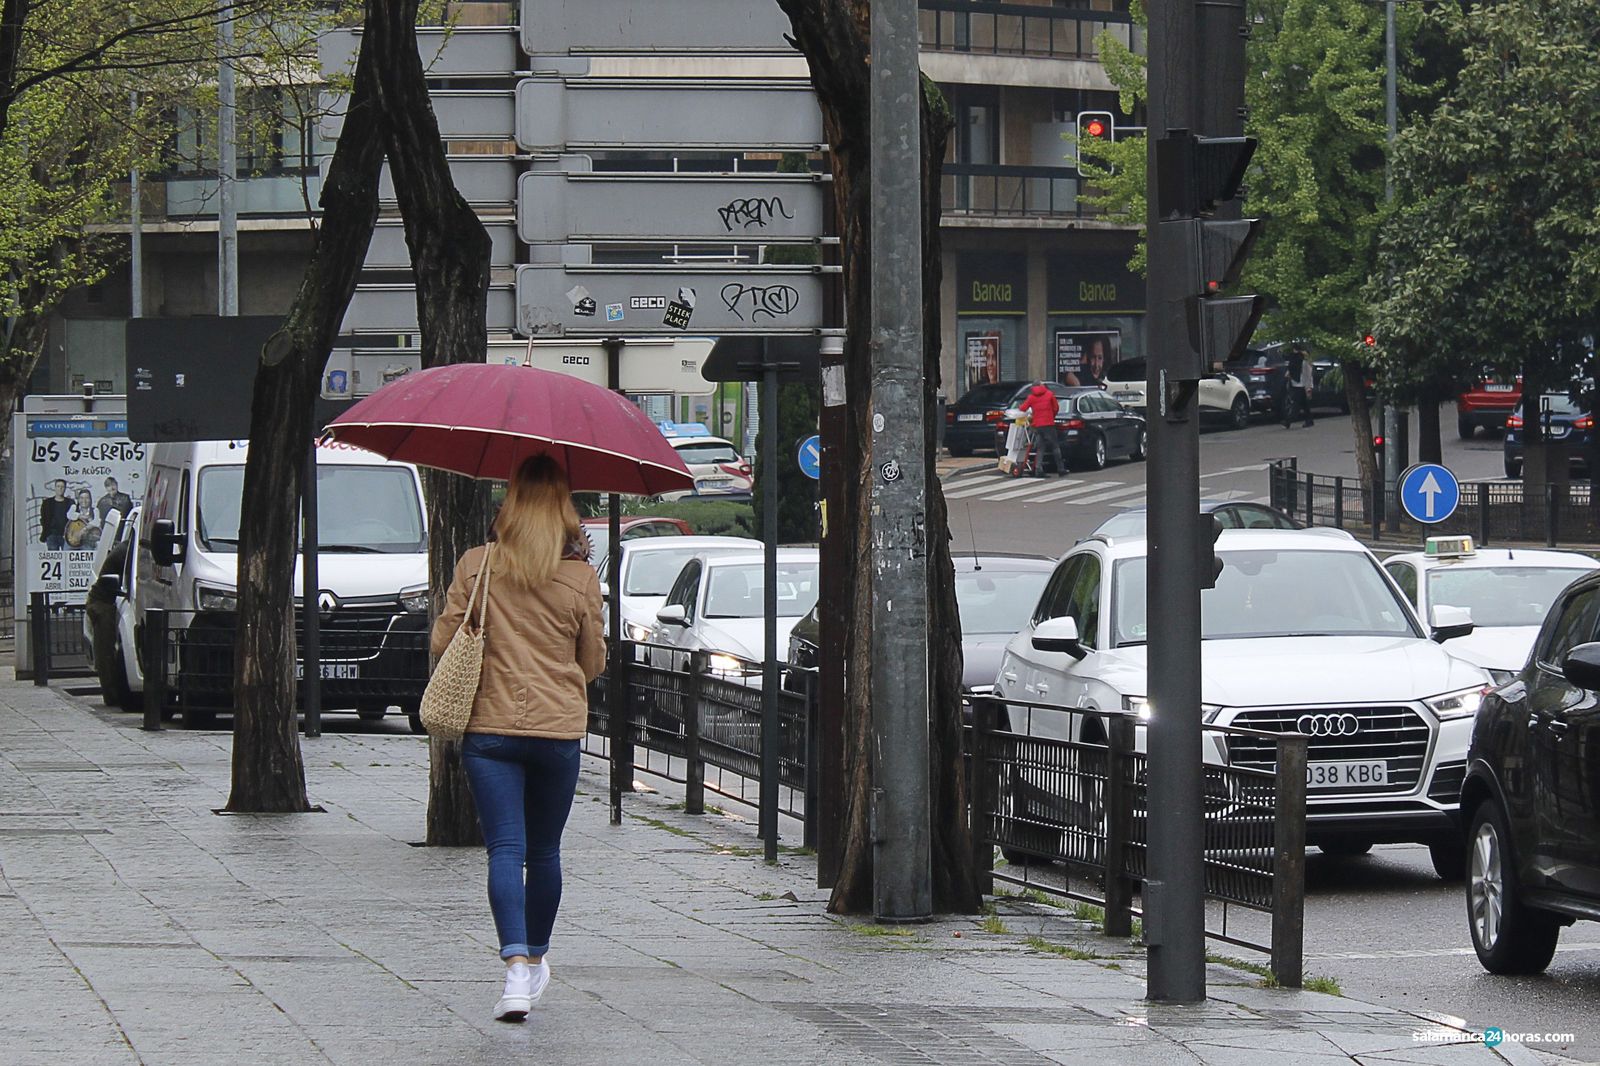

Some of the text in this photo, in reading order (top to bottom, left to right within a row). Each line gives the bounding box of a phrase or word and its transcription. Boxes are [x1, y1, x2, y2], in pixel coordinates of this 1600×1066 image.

[973, 281, 1012, 302] Bankia
[1079, 281, 1116, 302] Bankia
[665, 313, 687, 328] PLACE
[69, 552, 94, 561] CAEM
[40, 561, 62, 581] 24
[1306, 764, 1383, 784] 038 KBG
